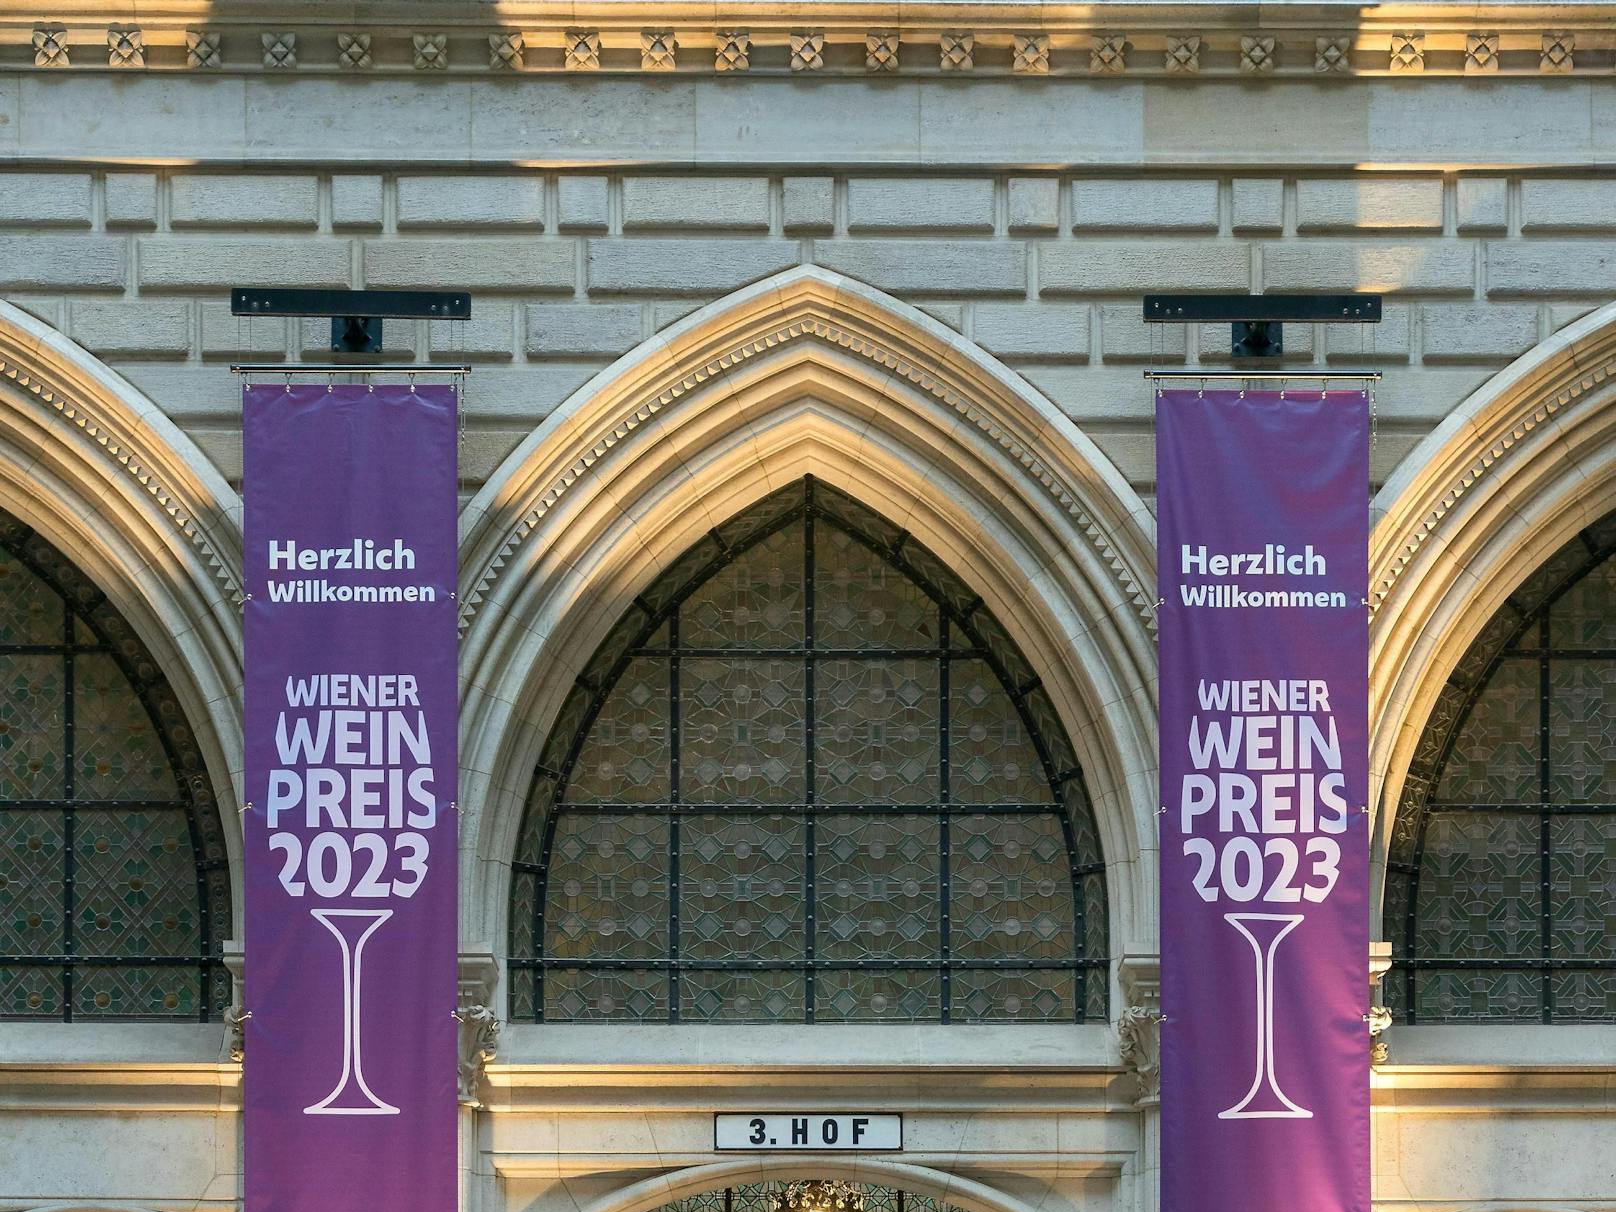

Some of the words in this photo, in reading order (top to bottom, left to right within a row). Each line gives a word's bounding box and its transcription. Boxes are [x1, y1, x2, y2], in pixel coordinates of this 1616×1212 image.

[268, 538, 416, 571] Herzlich
[1181, 543, 1327, 576] Herzlich
[267, 579, 436, 603] Willkommen
[1180, 584, 1347, 608] Willkommen
[285, 673, 421, 707] WIENER
[1197, 678, 1332, 713] WIENER
[275, 709, 432, 766] WEIN
[1188, 714, 1343, 771] WEIN
[266, 767, 437, 830] PREIS
[1180, 772, 1348, 835] PREIS
[268, 831, 430, 898] 2023
[1183, 836, 1341, 904] 2023
[749, 1118, 777, 1145] 3.
[791, 1118, 869, 1145] HOF
